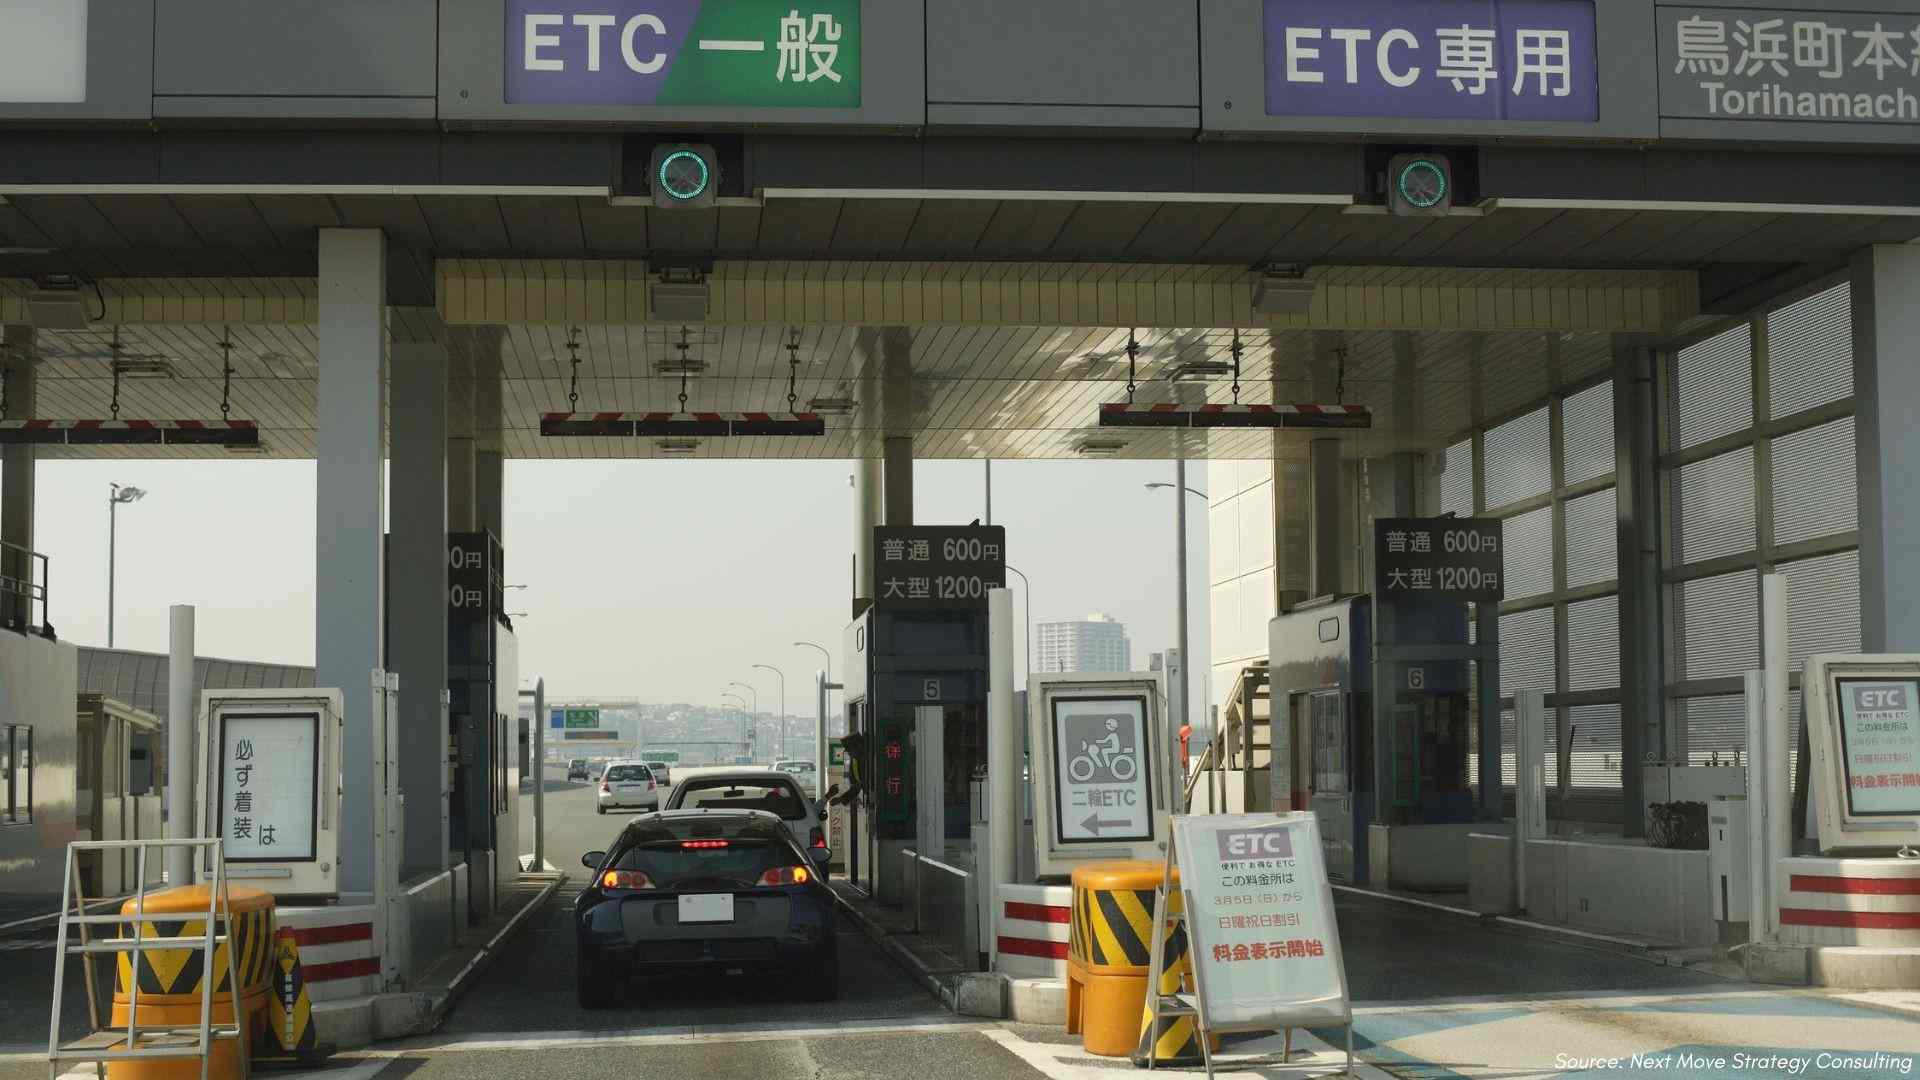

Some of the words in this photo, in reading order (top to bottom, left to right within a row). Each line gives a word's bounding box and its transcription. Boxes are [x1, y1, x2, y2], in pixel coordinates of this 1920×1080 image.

[525, 14, 667, 74] ETC
[699, 10, 842, 83] 一般
[1675, 17, 1920, 80] 鳥浜町本
[1699, 82, 1918, 119] Torihamach
[882, 538, 930, 561] 普通
[943, 538, 999, 561] 600円
[1386, 530, 1431, 552] 普通
[1444, 530, 1497, 552] 600円
[446, 546, 482, 569] 0円
[883, 576, 930, 599] 大型
[1387, 567, 1432, 590] 大型
[1436, 567, 1498, 590] 1200円
[446, 585, 482, 608] 0円
[926, 681, 938, 698] 5
[1411, 670, 1422, 687] 6
[1861, 690, 1900, 707] ETC
[233, 738, 254, 839] 必ず着装
[1072, 789, 1137, 808] 二輪ETC
[258, 824, 276, 846] は
[1227, 832, 1281, 855] ETC
[1222, 873, 1297, 887] この料金所は
[1219, 912, 1301, 929] 日曜祝日割引
[1213, 938, 1325, 963] 料金表示開始
